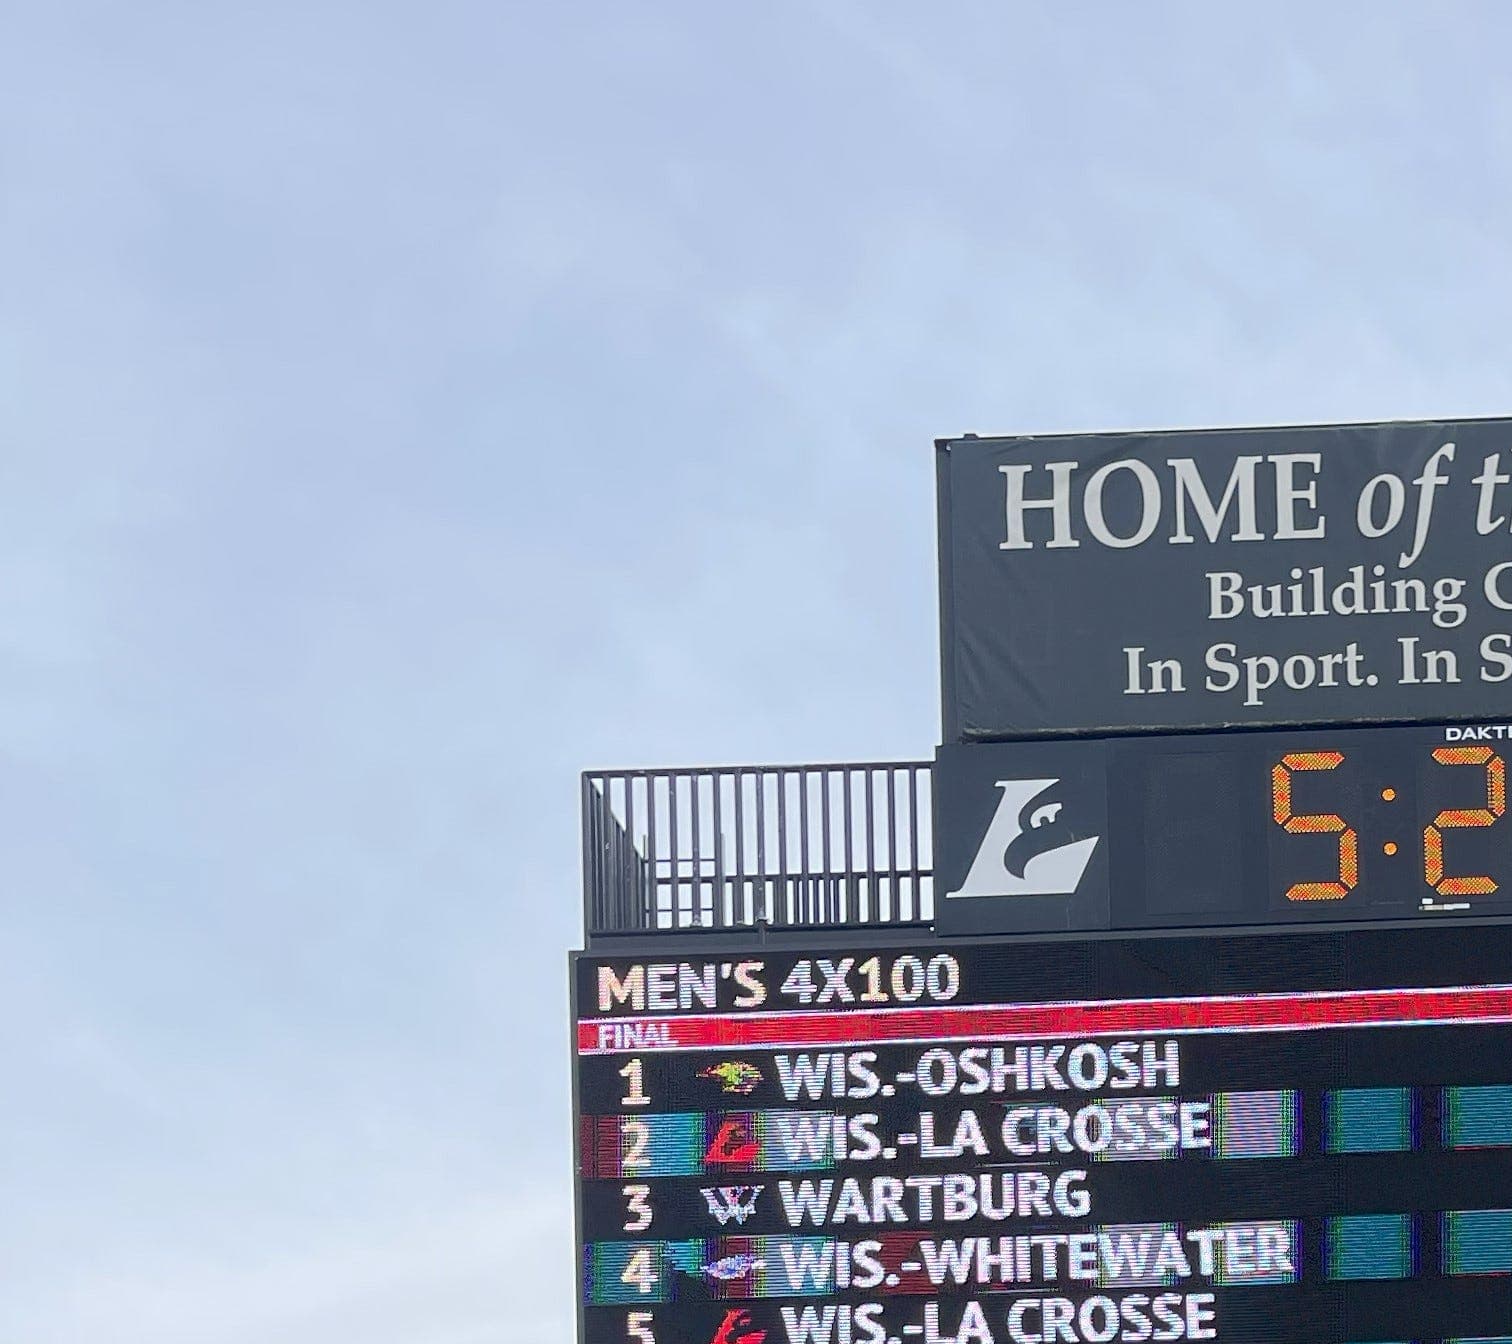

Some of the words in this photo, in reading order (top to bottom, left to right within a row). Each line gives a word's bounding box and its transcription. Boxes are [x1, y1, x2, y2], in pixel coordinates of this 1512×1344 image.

[998, 452, 1328, 552] HOME
[1357, 442, 1447, 569] of
[1206, 561, 1468, 626] Building
[1123, 647, 1187, 696] In
[1204, 639, 1379, 706] Sport.
[1400, 637, 1460, 685] In
[598, 960, 767, 1011] MEN'S
[780, 953, 960, 1003] 4X100
[598, 1022, 678, 1049] FINAL
[619, 1059, 651, 1105] 1
[775, 1040, 1180, 1101] WIS.-OSHKOSH
[620, 1123, 651, 1168] 2
[777, 1110, 990, 1161] WIS.-LA
[1002, 1102, 1212, 1156] CROSSE
[620, 1184, 652, 1231] 3
[778, 1170, 1091, 1226] WARTBURG
[620, 1249, 659, 1293] 4
[780, 1228, 1295, 1289] WIS.-WHITEWATER
